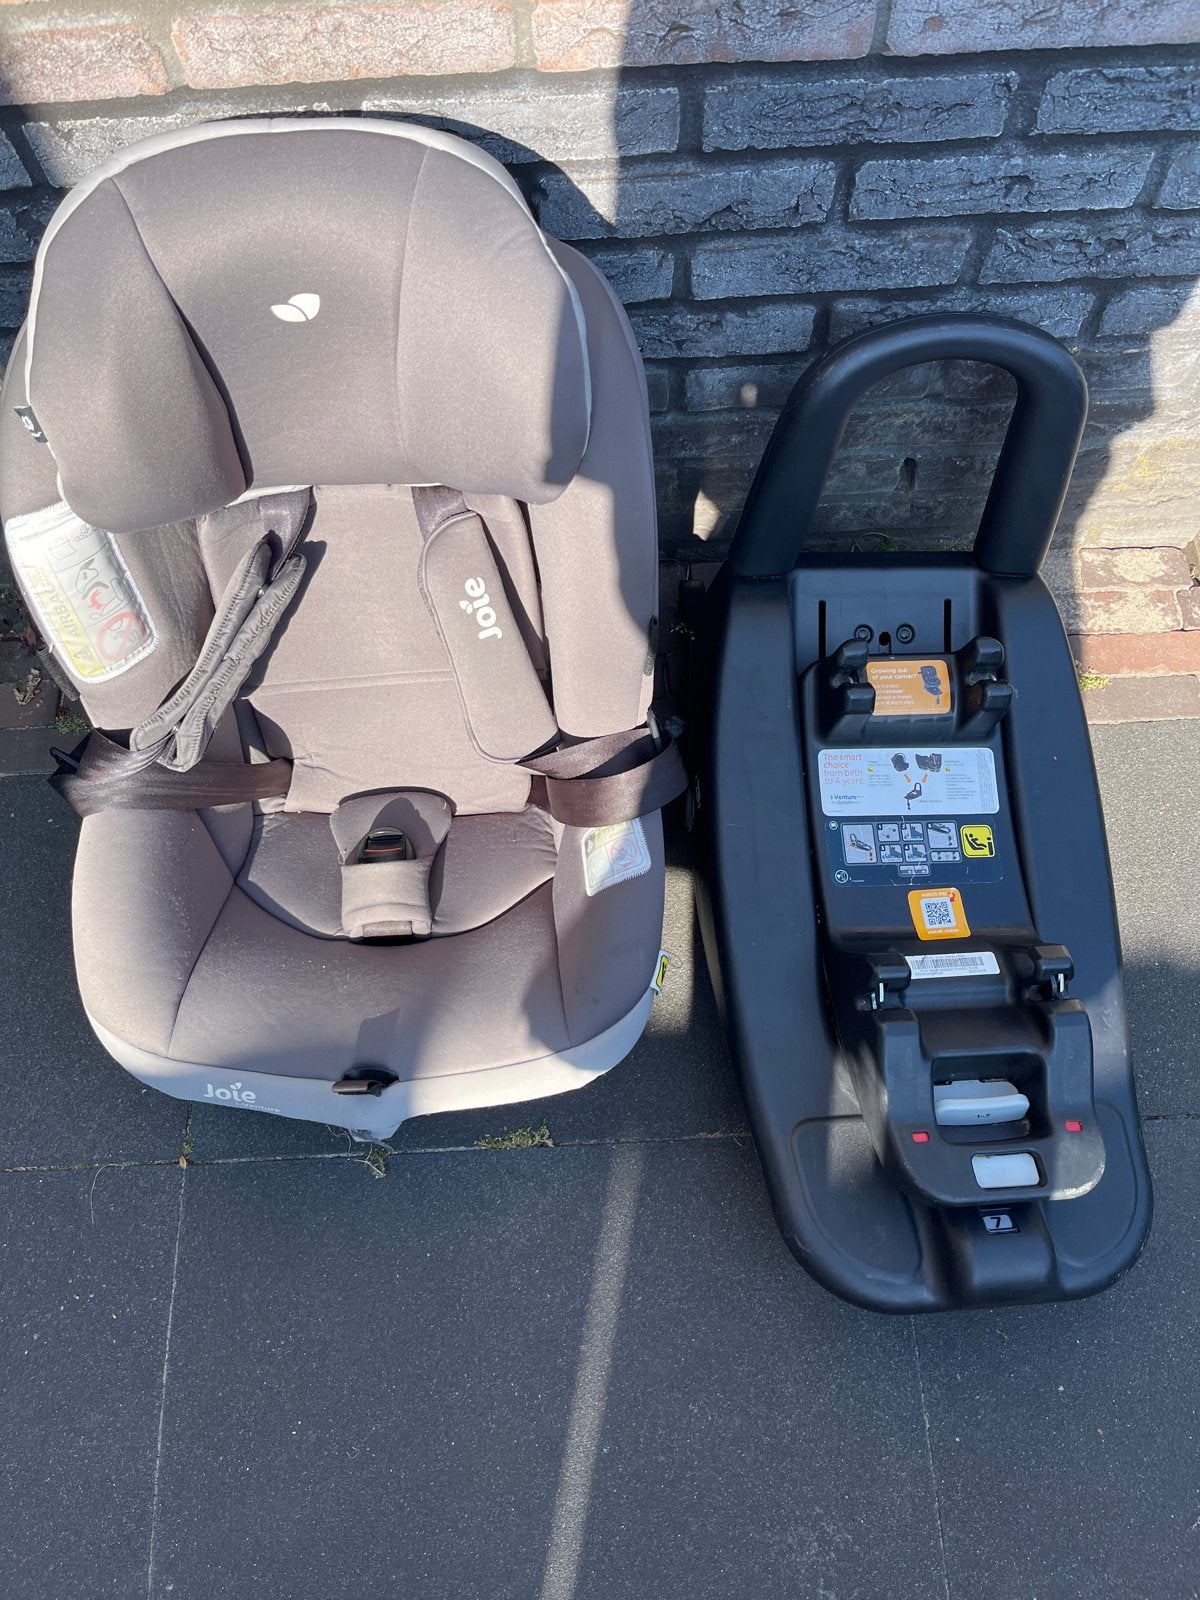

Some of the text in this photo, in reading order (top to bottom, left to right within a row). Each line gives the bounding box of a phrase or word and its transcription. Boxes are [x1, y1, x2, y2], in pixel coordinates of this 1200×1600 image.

[459, 577, 503, 640] Joie
[844, 769, 864, 777] birth
[204, 1082, 256, 1103] Joie
[990, 1217, 1001, 1228] 7
